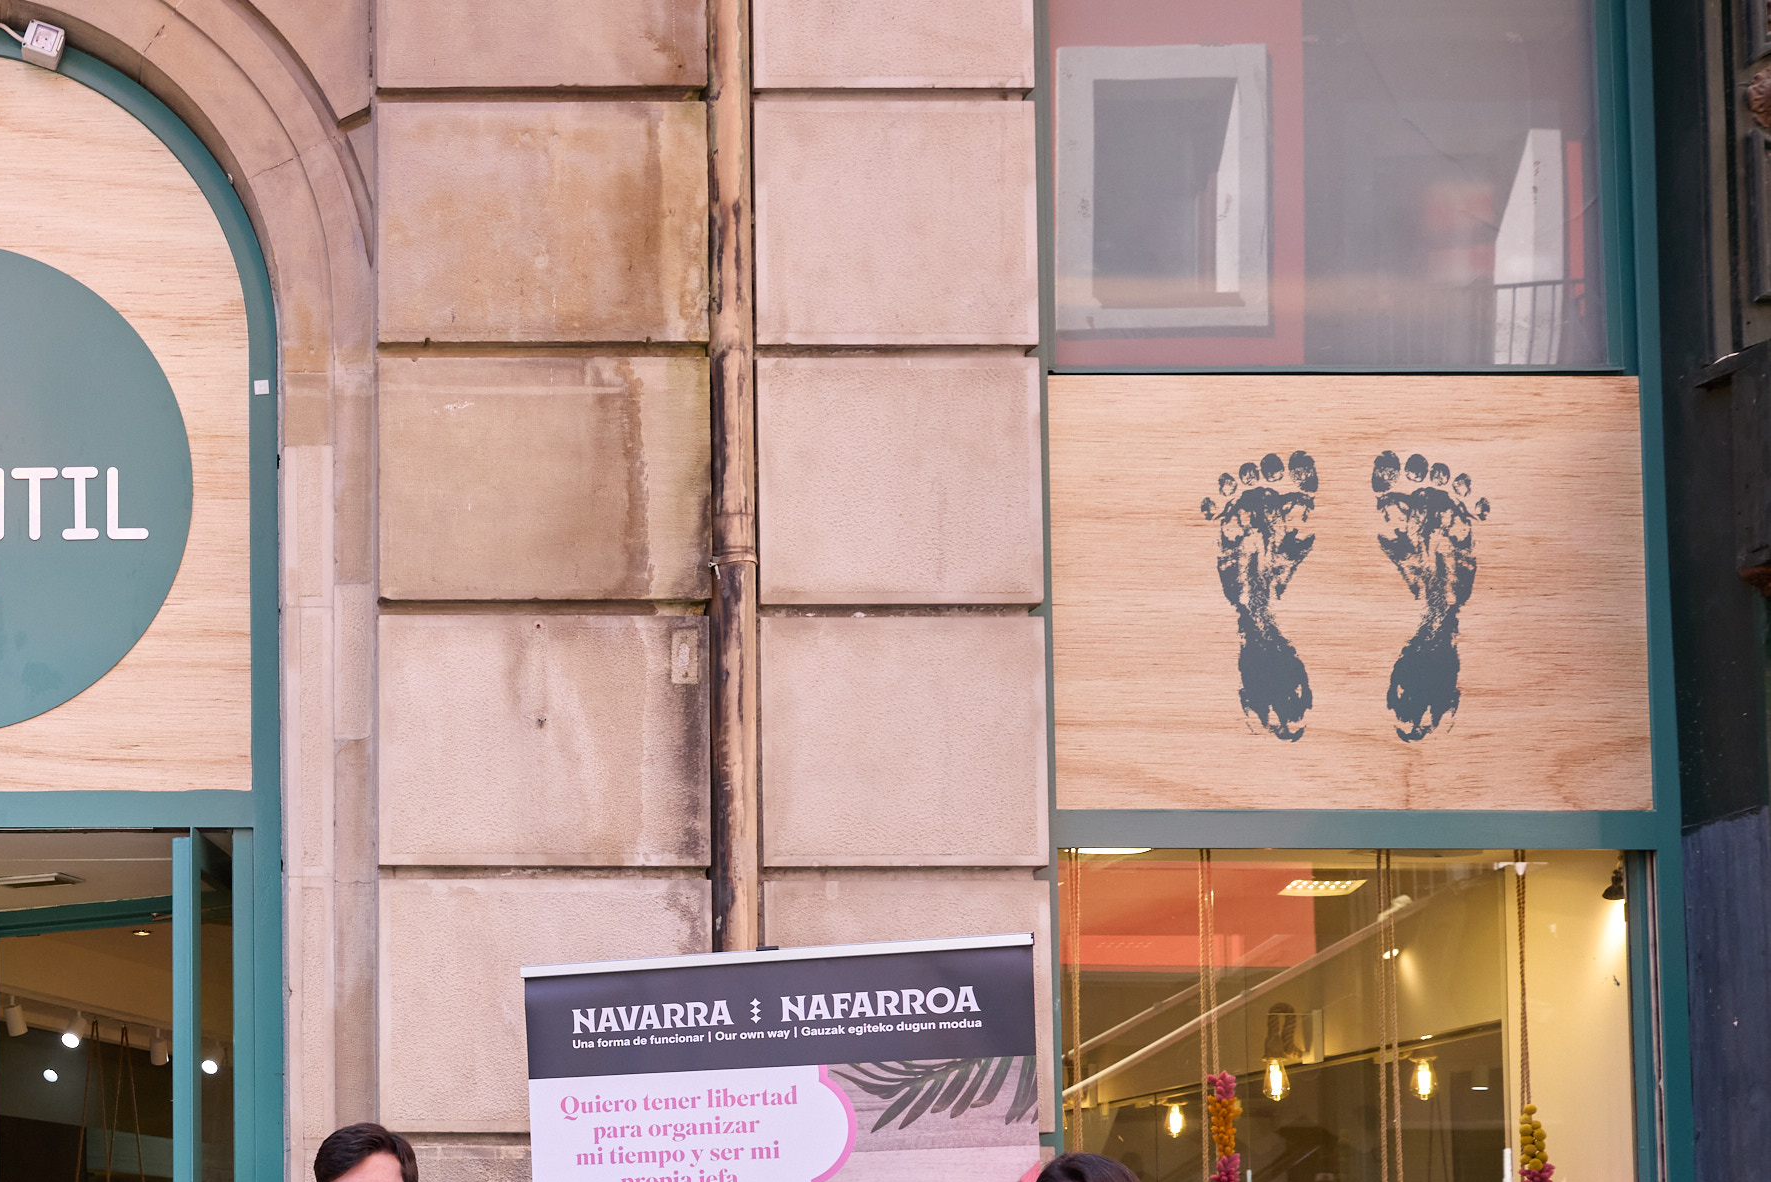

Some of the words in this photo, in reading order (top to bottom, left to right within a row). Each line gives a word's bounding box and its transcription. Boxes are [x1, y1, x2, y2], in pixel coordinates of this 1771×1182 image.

[572, 1000, 735, 1034] NAVARRA
[780, 985, 981, 1022] NAFARROA
[572, 1038, 595, 1049] Una
[597, 1036, 631, 1048] forma
[633, 1035, 648, 1046] de
[650, 1032, 705, 1045] funcionar
[715, 1030, 738, 1041] Our
[740, 1030, 764, 1040] own
[766, 1028, 790, 1040] way
[801, 1024, 846, 1037] Gauzak
[848, 1022, 894, 1036] egiteko
[896, 1020, 936, 1034] dugun
[939, 1018, 982, 1030] modua
[560, 1095, 637, 1121] Quiero
[643, 1094, 701, 1111] tener
[706, 1084, 798, 1108] libertad
[593, 1124, 642, 1144] para
[648, 1115, 760, 1142] organizar
[576, 1146, 604, 1166] mi
[609, 1146, 685, 1168] tiempo
[690, 1148, 703, 1168] y
[709, 1146, 745, 1162] ser
[750, 1140, 780, 1160] mi
